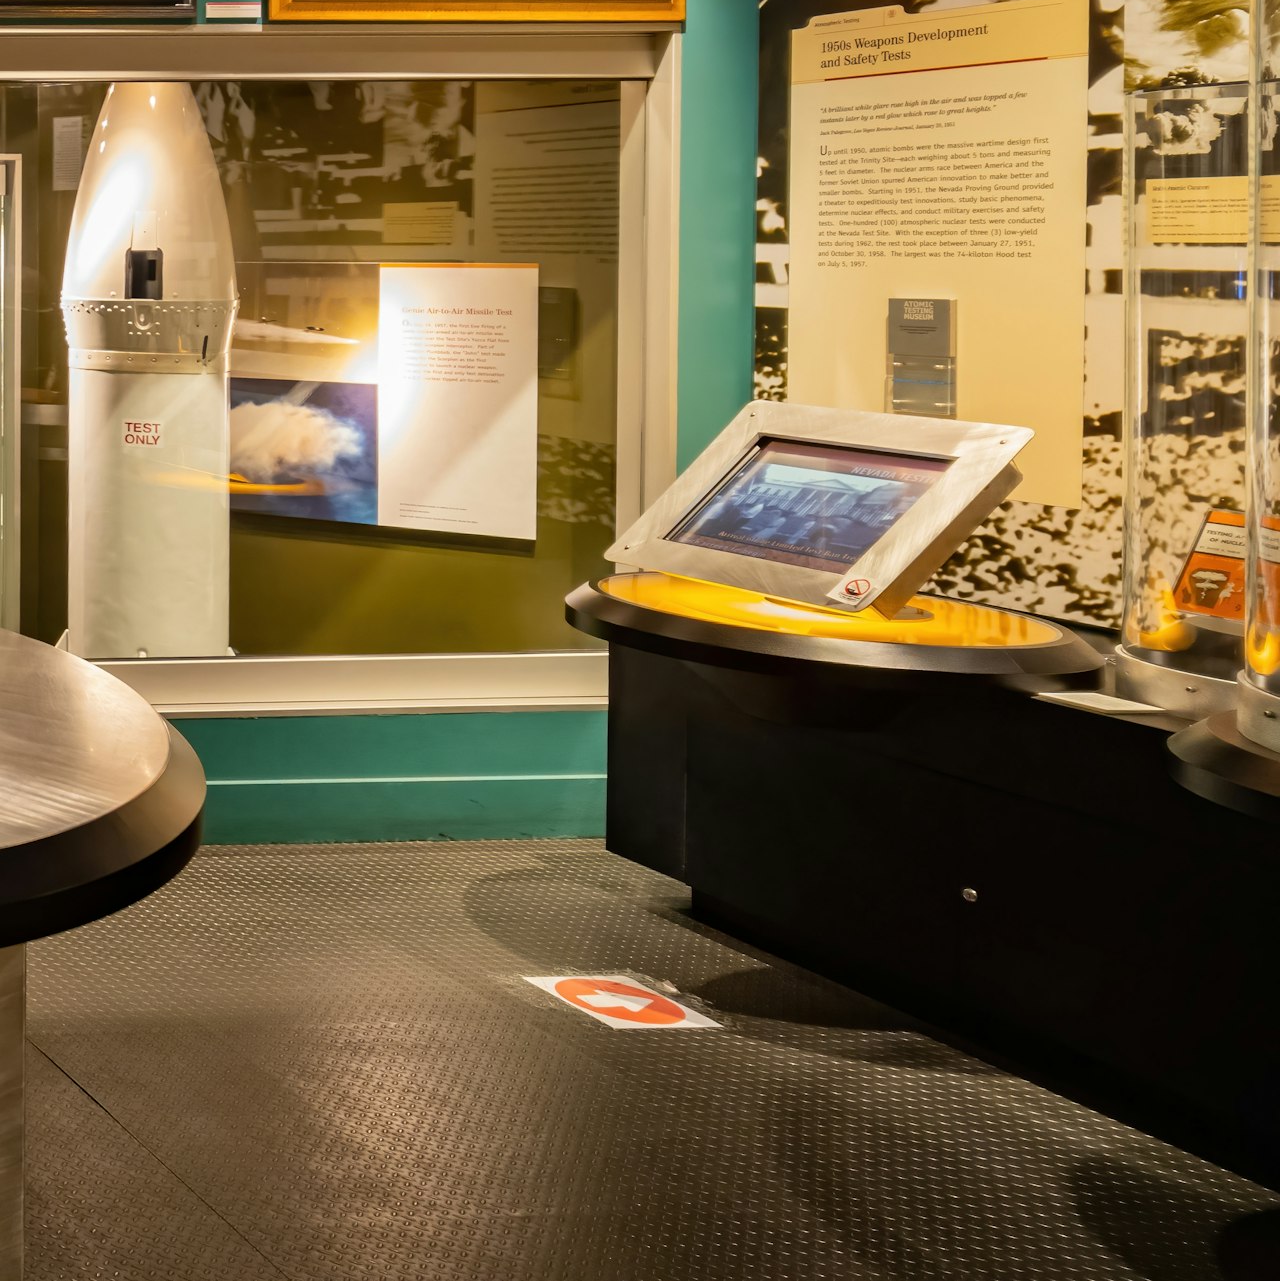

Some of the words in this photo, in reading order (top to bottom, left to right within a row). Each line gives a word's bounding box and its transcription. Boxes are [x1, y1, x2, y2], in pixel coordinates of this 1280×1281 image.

[821, 41, 852, 54] 1950s
[854, 35, 904, 50] Weapons
[908, 24, 989, 43] Development
[820, 56, 840, 68] and
[844, 52, 878, 66] Safety
[881, 49, 912, 62] Tests
[820, 146, 832, 156] Up
[833, 146, 848, 155] until
[869, 144, 891, 153] atomic
[893, 143, 914, 152] bombs
[933, 141, 945, 150] the
[947, 140, 974, 149] massive
[976, 138, 1004, 147] wartime
[1007, 137, 1031, 147] design
[1033, 136, 1049, 144] first
[943, 207, 970, 216] military
[1022, 206, 1045, 214] safety
[925, 229, 958, 237] exception
[990, 229, 1001, 237] (3)
[1004, 228, 1038, 237] low-yield
[834, 240, 854, 248] during
[856, 240, 873, 248] 1962,
[919, 240, 937, 248] place
[969, 240, 998, 248] January
[1000, 240, 1012, 248] 27,
[1015, 240, 1035, 248] 1951,
[856, 250, 866, 258] 30,
[904, 250, 926, 259] largest
[827, 260, 840, 268] July
[466, 308, 493, 316] Missile
[125, 422, 160, 433] TEST
[125, 434, 160, 445] ONLY
[850, 466, 896, 479] NEVADA
[771, 540, 804, 551] Limited
[805, 545, 821, 554] Test
